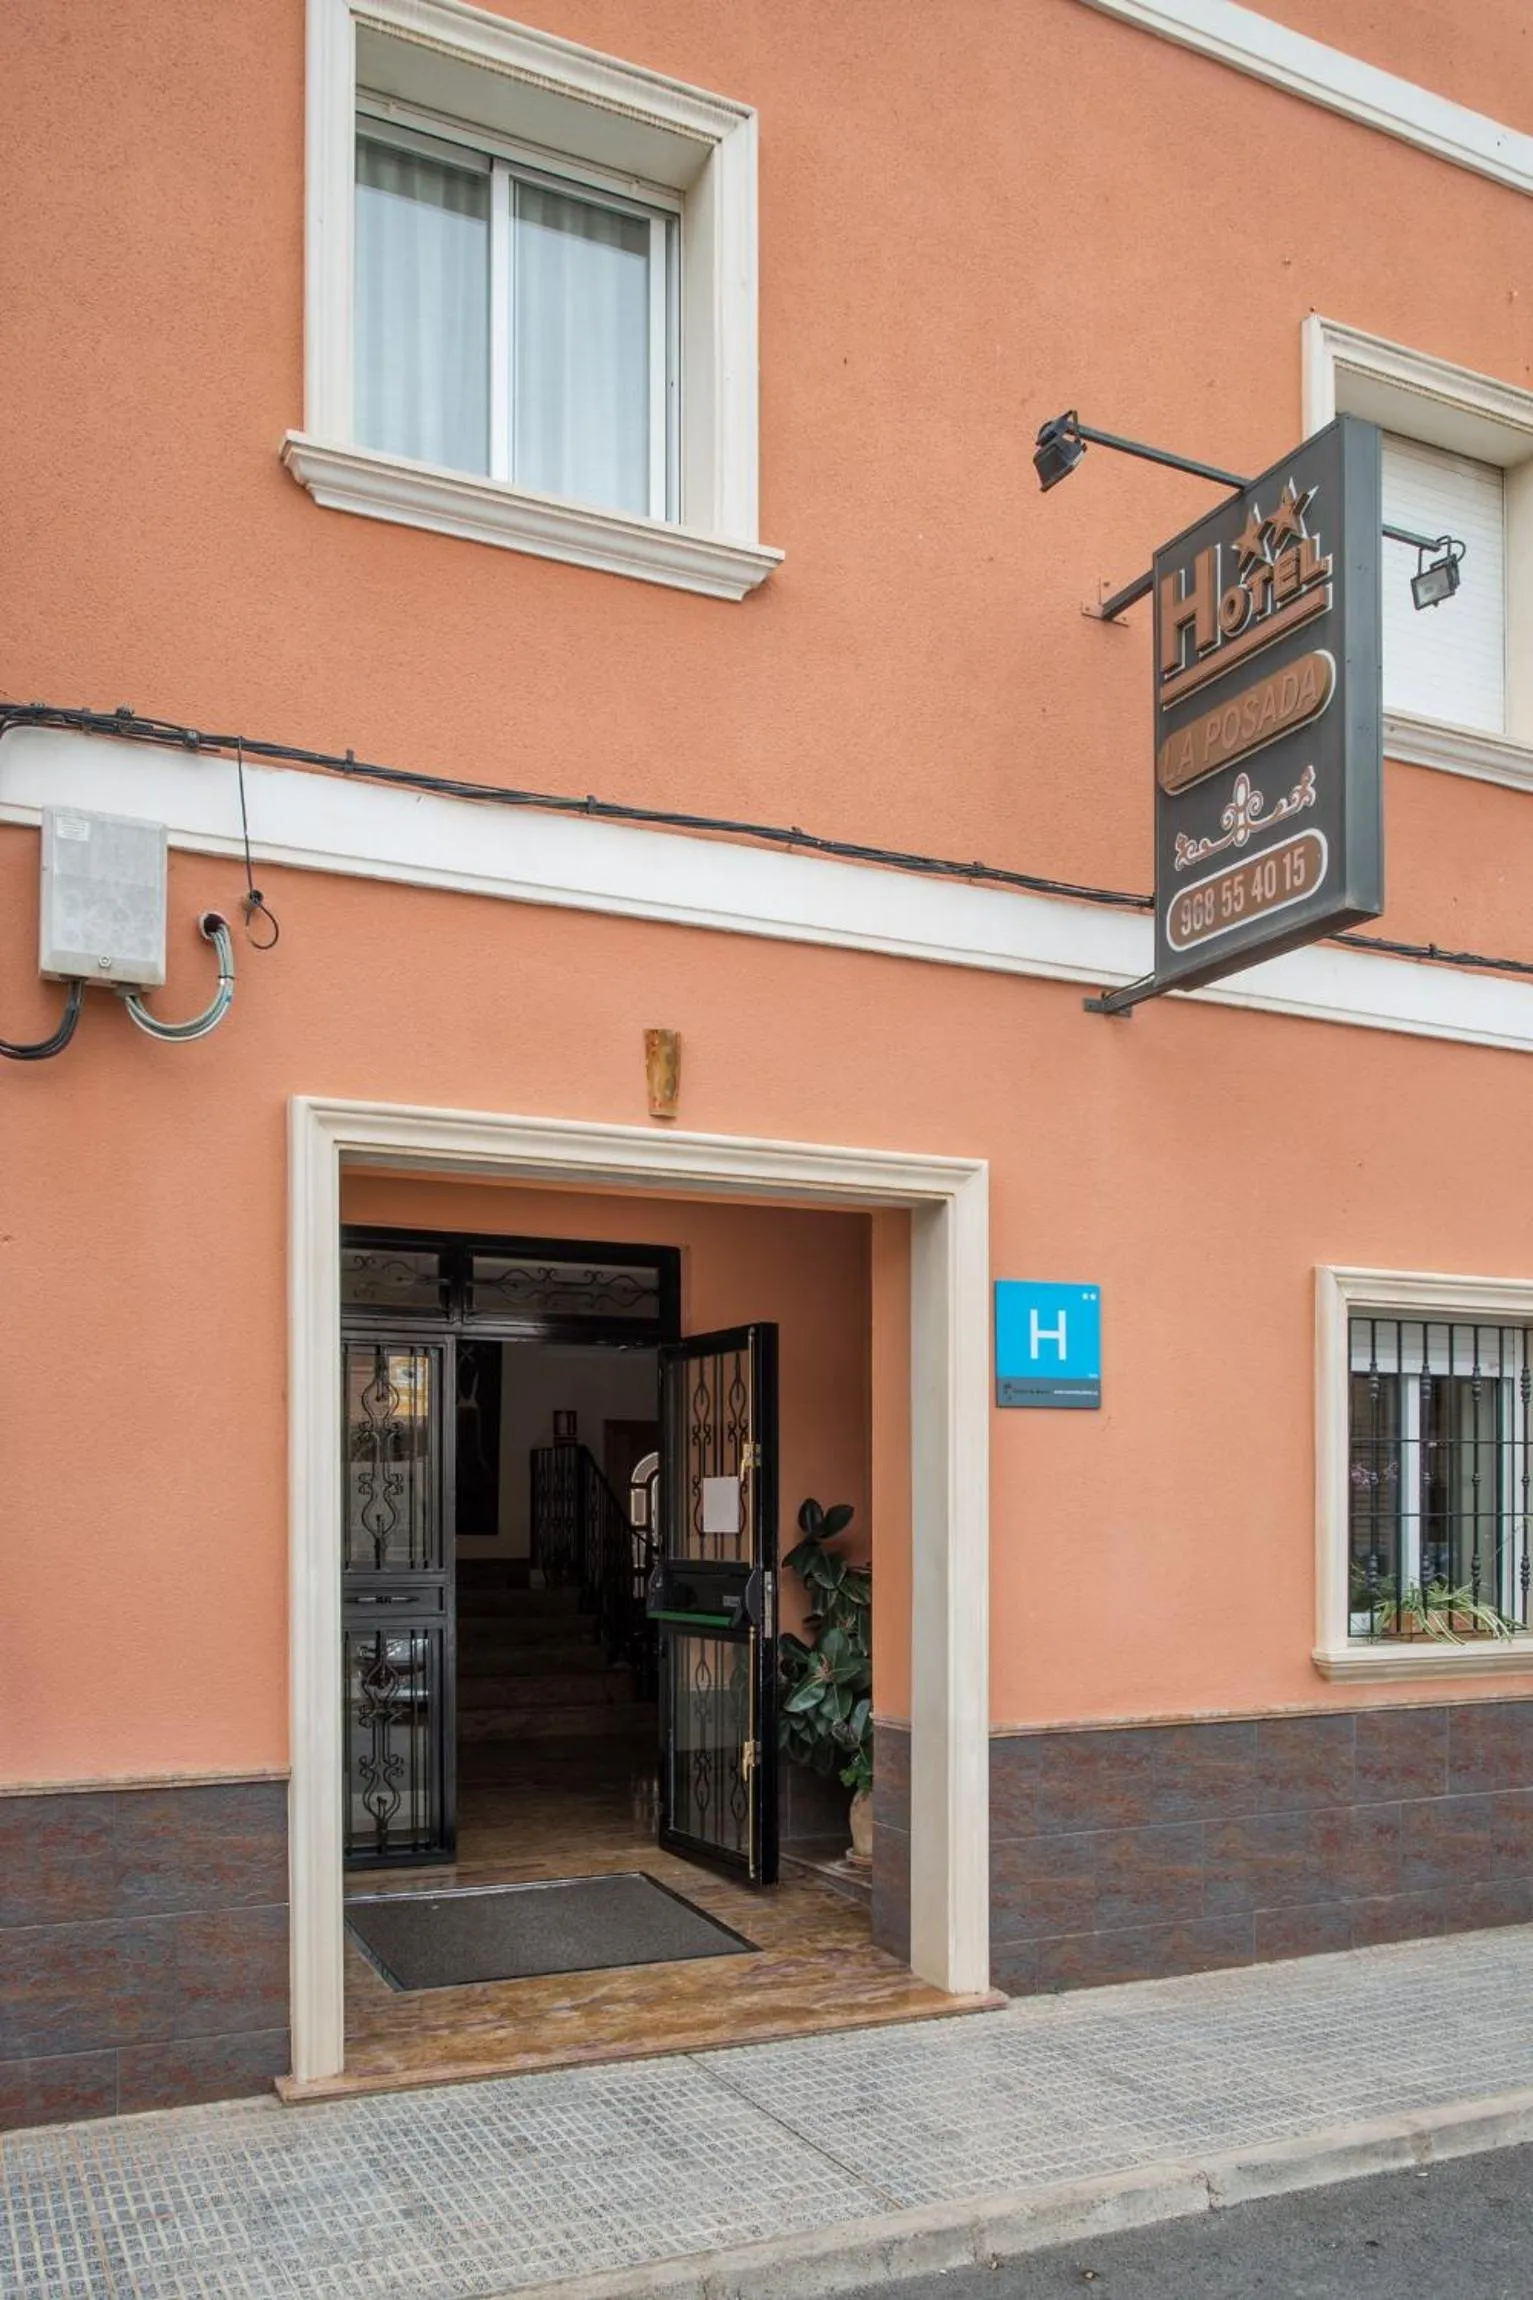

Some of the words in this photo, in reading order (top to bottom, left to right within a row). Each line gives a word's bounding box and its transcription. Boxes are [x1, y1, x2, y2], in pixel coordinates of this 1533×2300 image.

[1160, 533, 1333, 680] HOTEL
[1163, 734, 1194, 779] LA
[1204, 664, 1318, 762] POSADA
[1180, 892, 1216, 936] 968
[1221, 873, 1245, 921] 55
[1251, 860, 1277, 902] 40
[1282, 846, 1306, 890] 15
[1030, 1309, 1066, 1360] H
